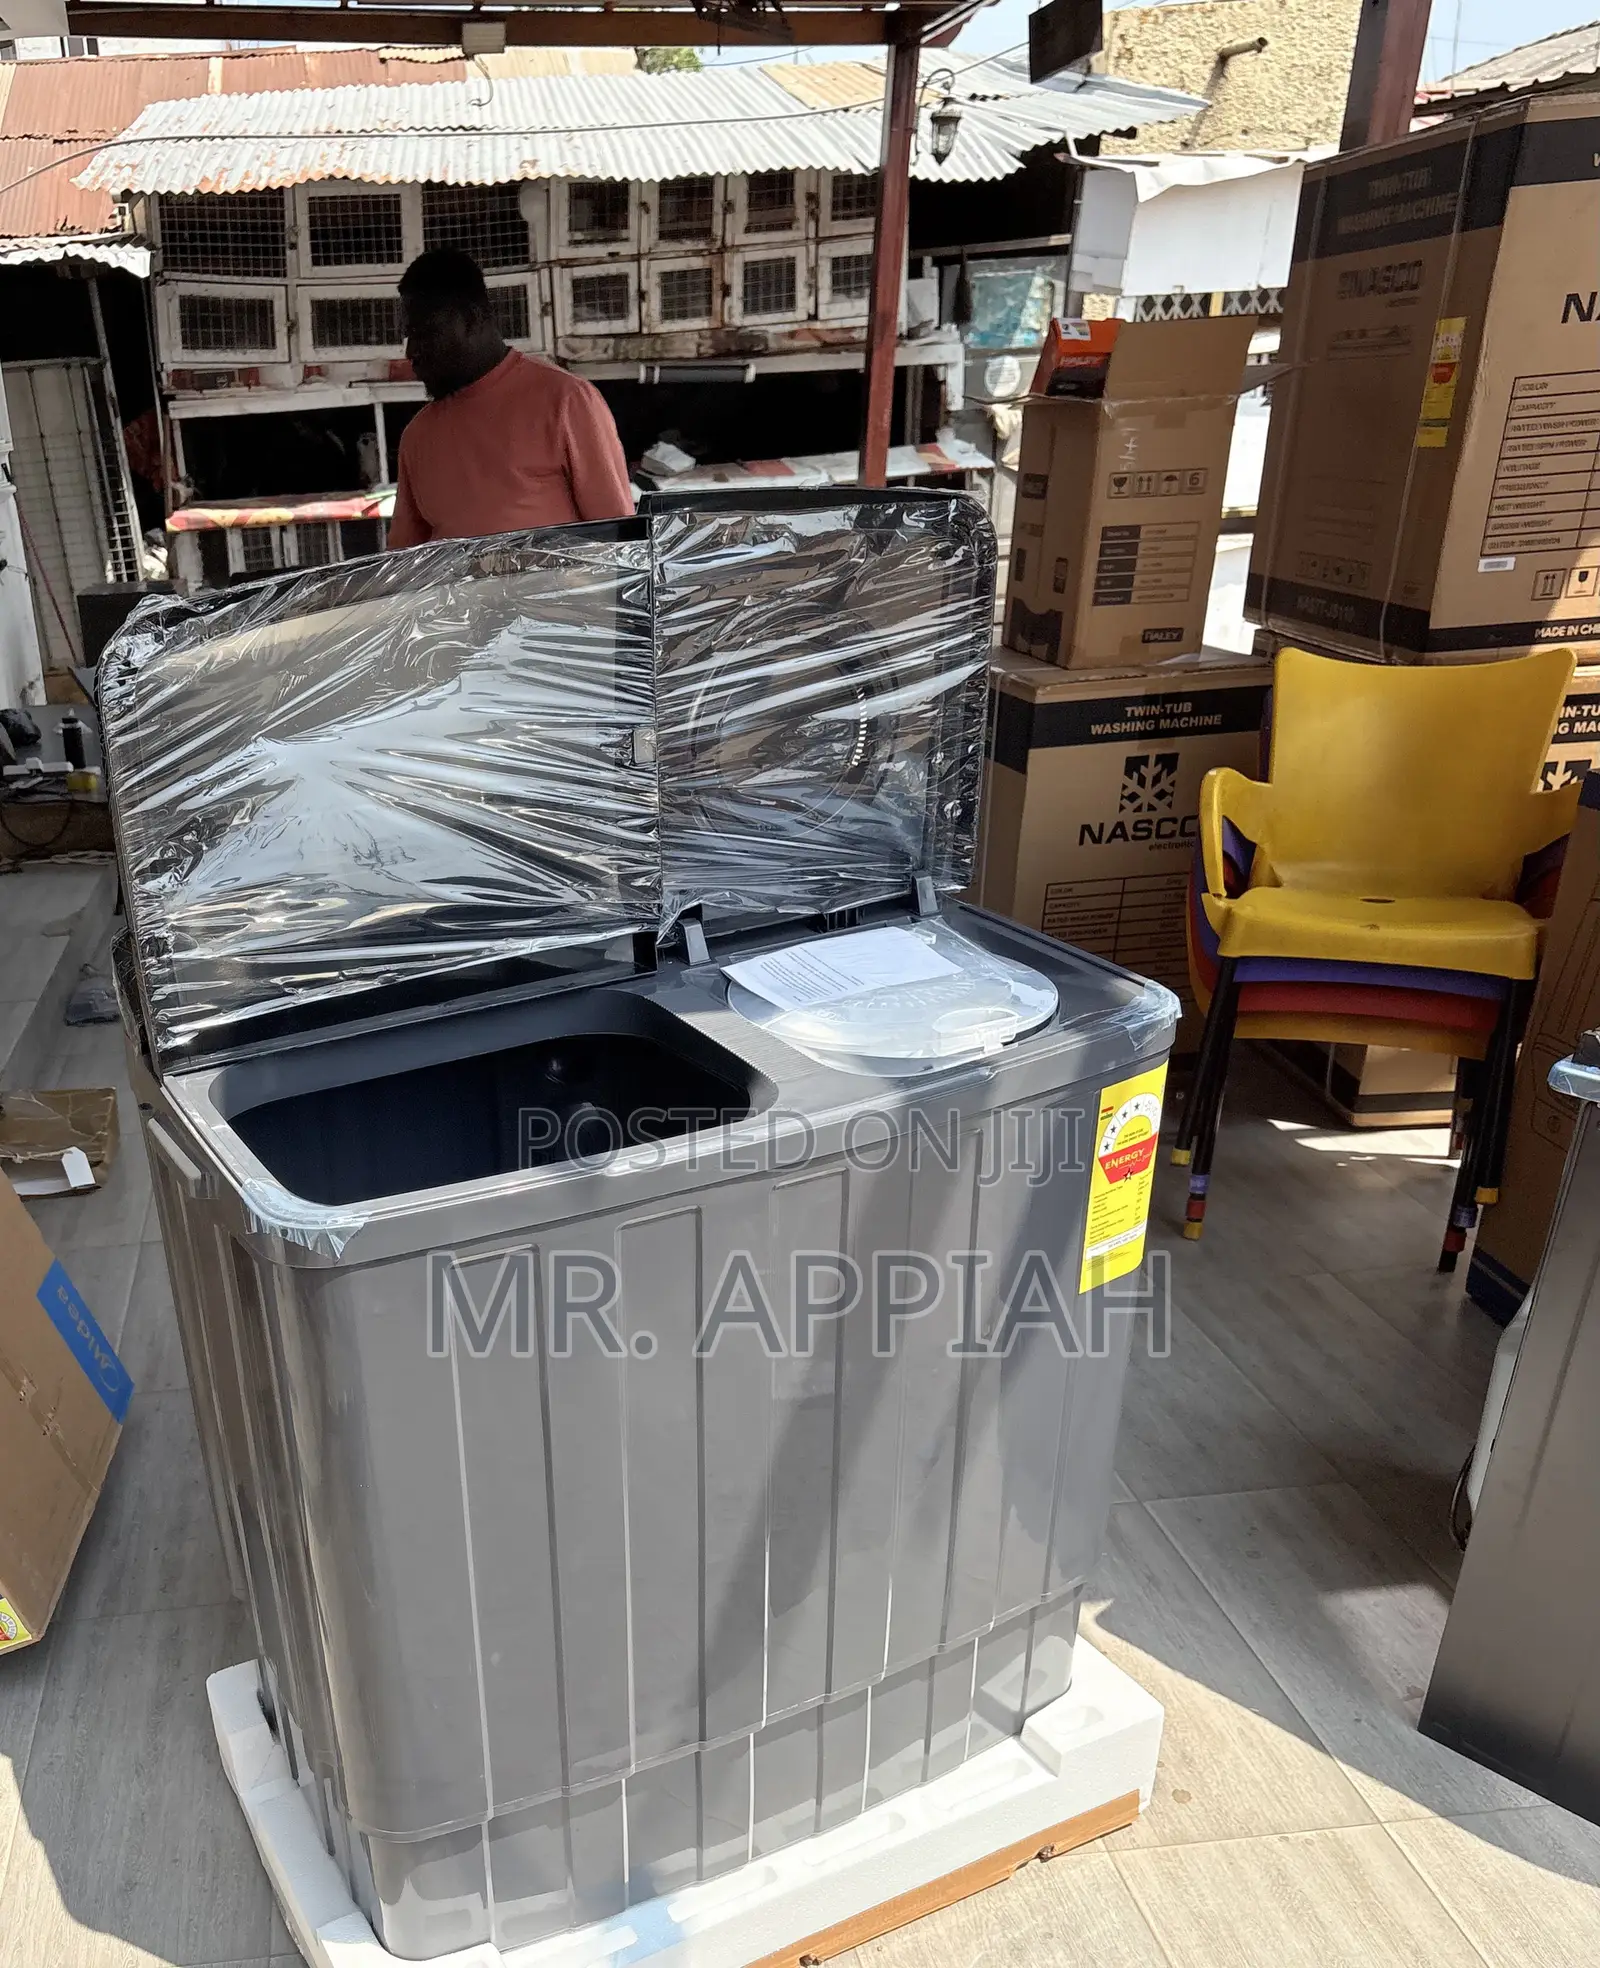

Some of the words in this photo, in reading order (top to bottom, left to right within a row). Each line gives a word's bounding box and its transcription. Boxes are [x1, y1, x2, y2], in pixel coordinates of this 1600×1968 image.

[1535, 625, 1566, 639] MADE
[1567, 624, 1580, 636] IN
[1125, 701, 1193, 718] TWIN-TUB
[1091, 720, 1155, 736] WASHING
[1159, 714, 1222, 730] MACHINE
[1105, 1147, 1145, 1170] ENERGY
